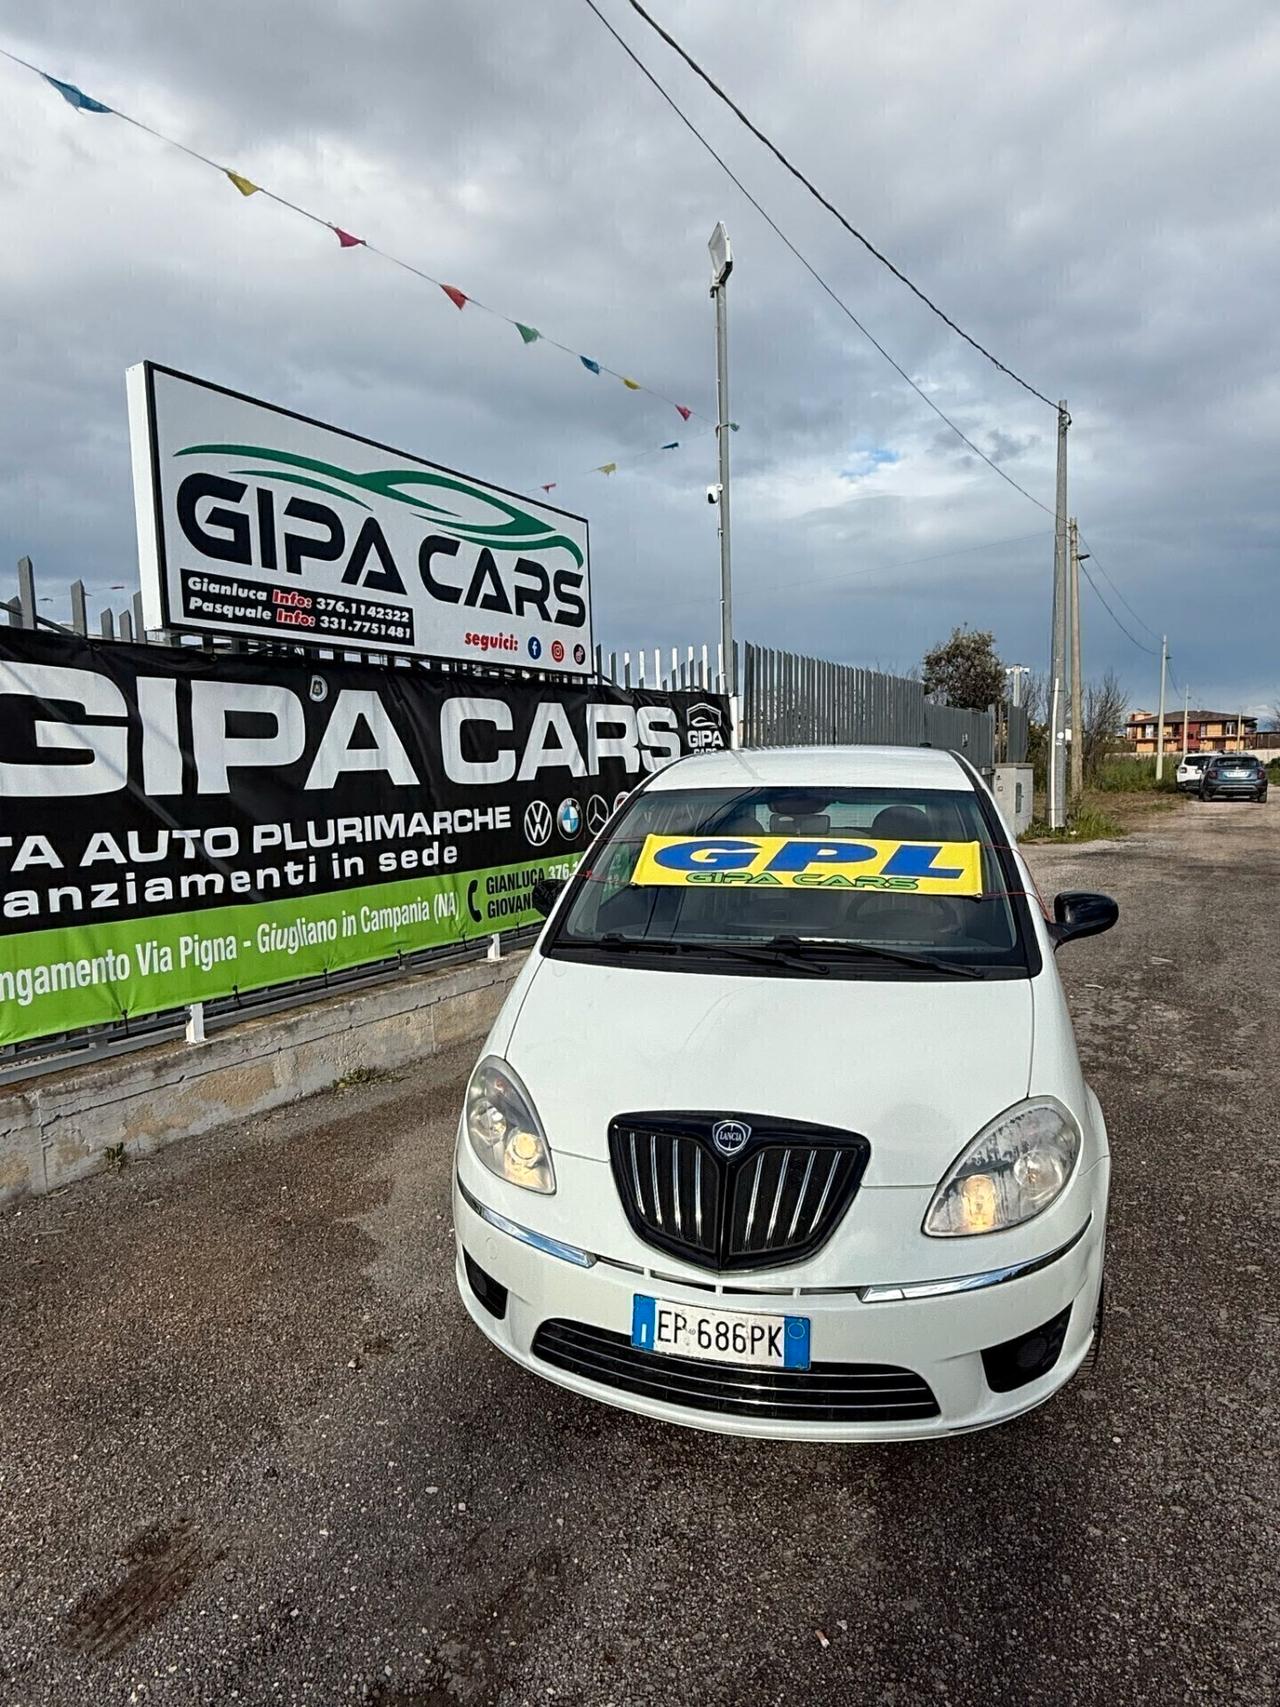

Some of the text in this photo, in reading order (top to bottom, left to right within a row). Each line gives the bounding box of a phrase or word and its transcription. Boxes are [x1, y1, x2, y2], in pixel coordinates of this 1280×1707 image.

[176, 473, 586, 628] GIPA CARS
[187, 576, 410, 624] Gianluca Info: 376.1142322
[189, 596, 411, 640] Pasquale Info: 331.7751481
[464, 632, 519, 652] seguici:
[0, 660, 681, 798] GIPA CARS
[687, 730, 725, 748] GIPA
[79, 826, 240, 868] AUTO
[252, 806, 512, 854] PLURIMARCHE
[331, 852, 364, 879] in
[379, 842, 458, 873] sede
[653, 839, 965, 880] GPL
[486, 867, 545, 895] GIANLUCA
[685, 872, 920, 891] GIPA CARS
[135, 940, 173, 977] Via
[180, 932, 238, 972] Pigna
[256, 917, 337, 955] Giugliano
[342, 910, 357, 937] in
[360, 897, 430, 933] Campania
[433, 892, 460, 924] (NA)
[719, 1130, 742, 1142] LANCIA
